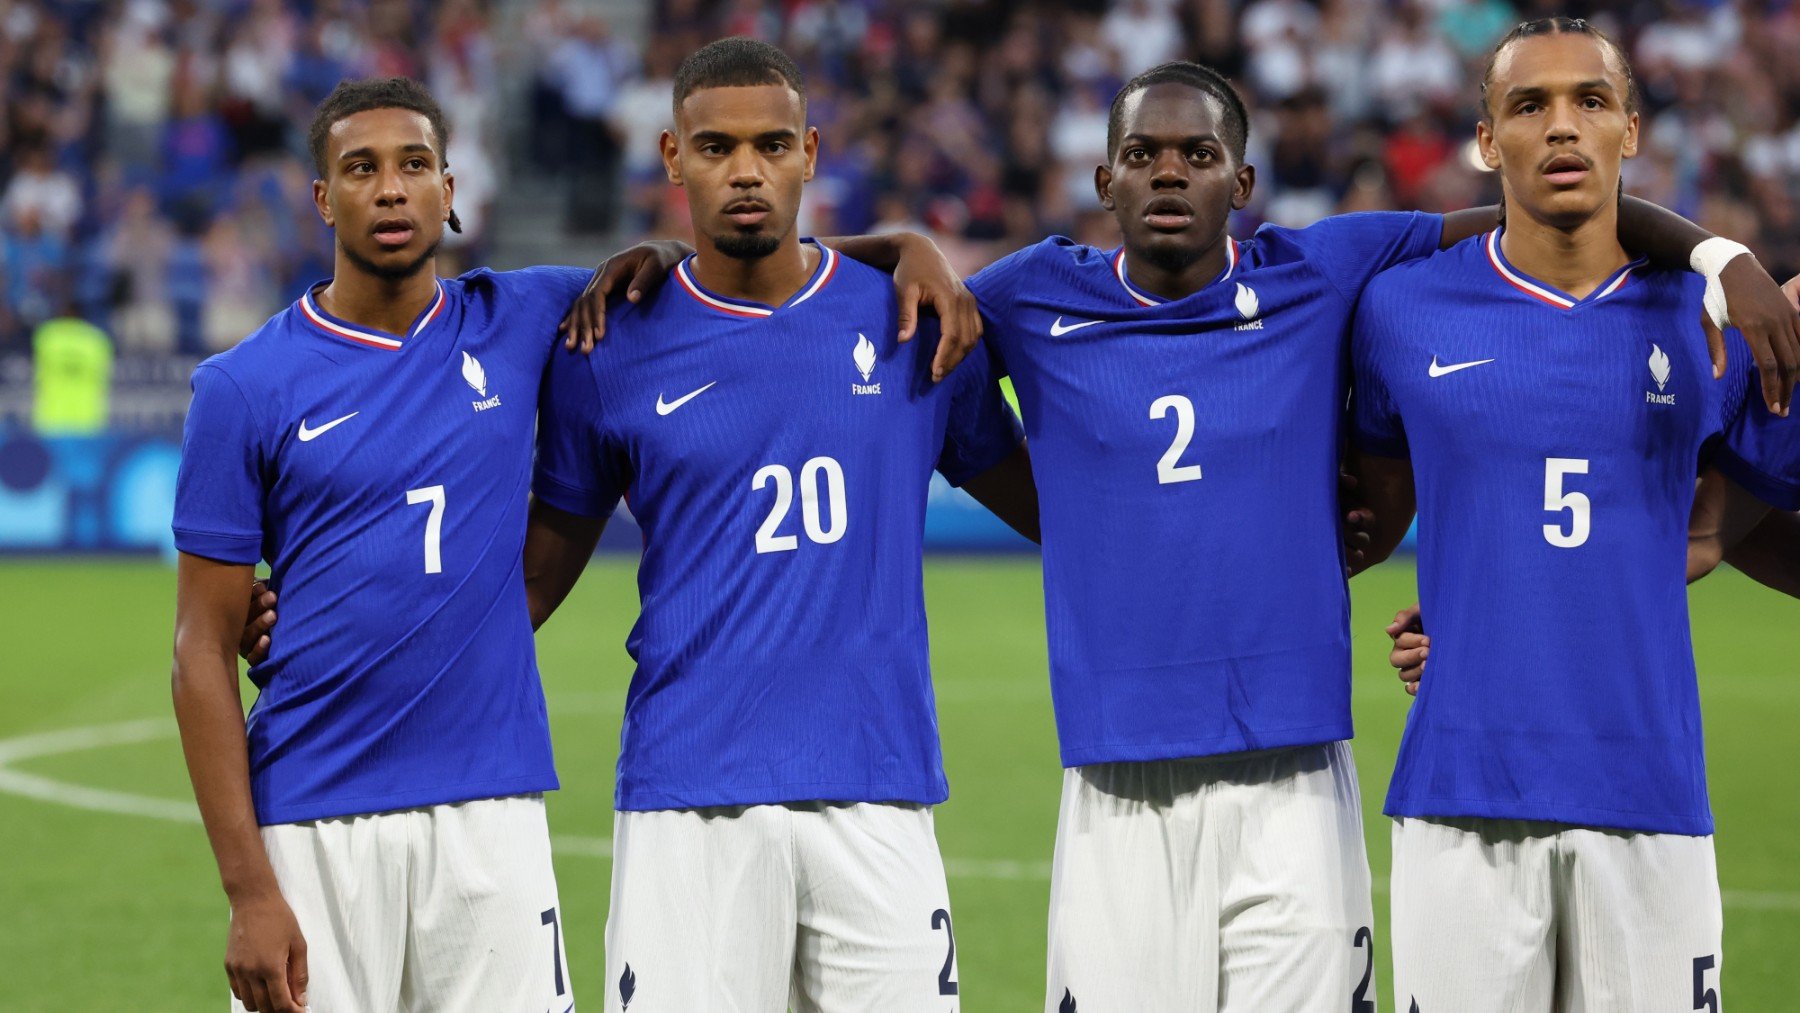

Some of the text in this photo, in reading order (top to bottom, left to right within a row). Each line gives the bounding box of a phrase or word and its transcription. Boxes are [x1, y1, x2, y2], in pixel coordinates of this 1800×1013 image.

[472, 393, 502, 412] FRANCE
[852, 382, 881, 395] FRANCE
[1646, 391, 1676, 405] FRANCE
[1149, 395, 1203, 484] 2
[405, 485, 446, 574] 7
[751, 456, 848, 553] 20
[1542, 457, 1591, 548] 5
[540, 907, 565, 997] 7
[931, 908, 958, 996] 2
[1352, 925, 1375, 1013] 2
[1692, 954, 1718, 1013] 5
